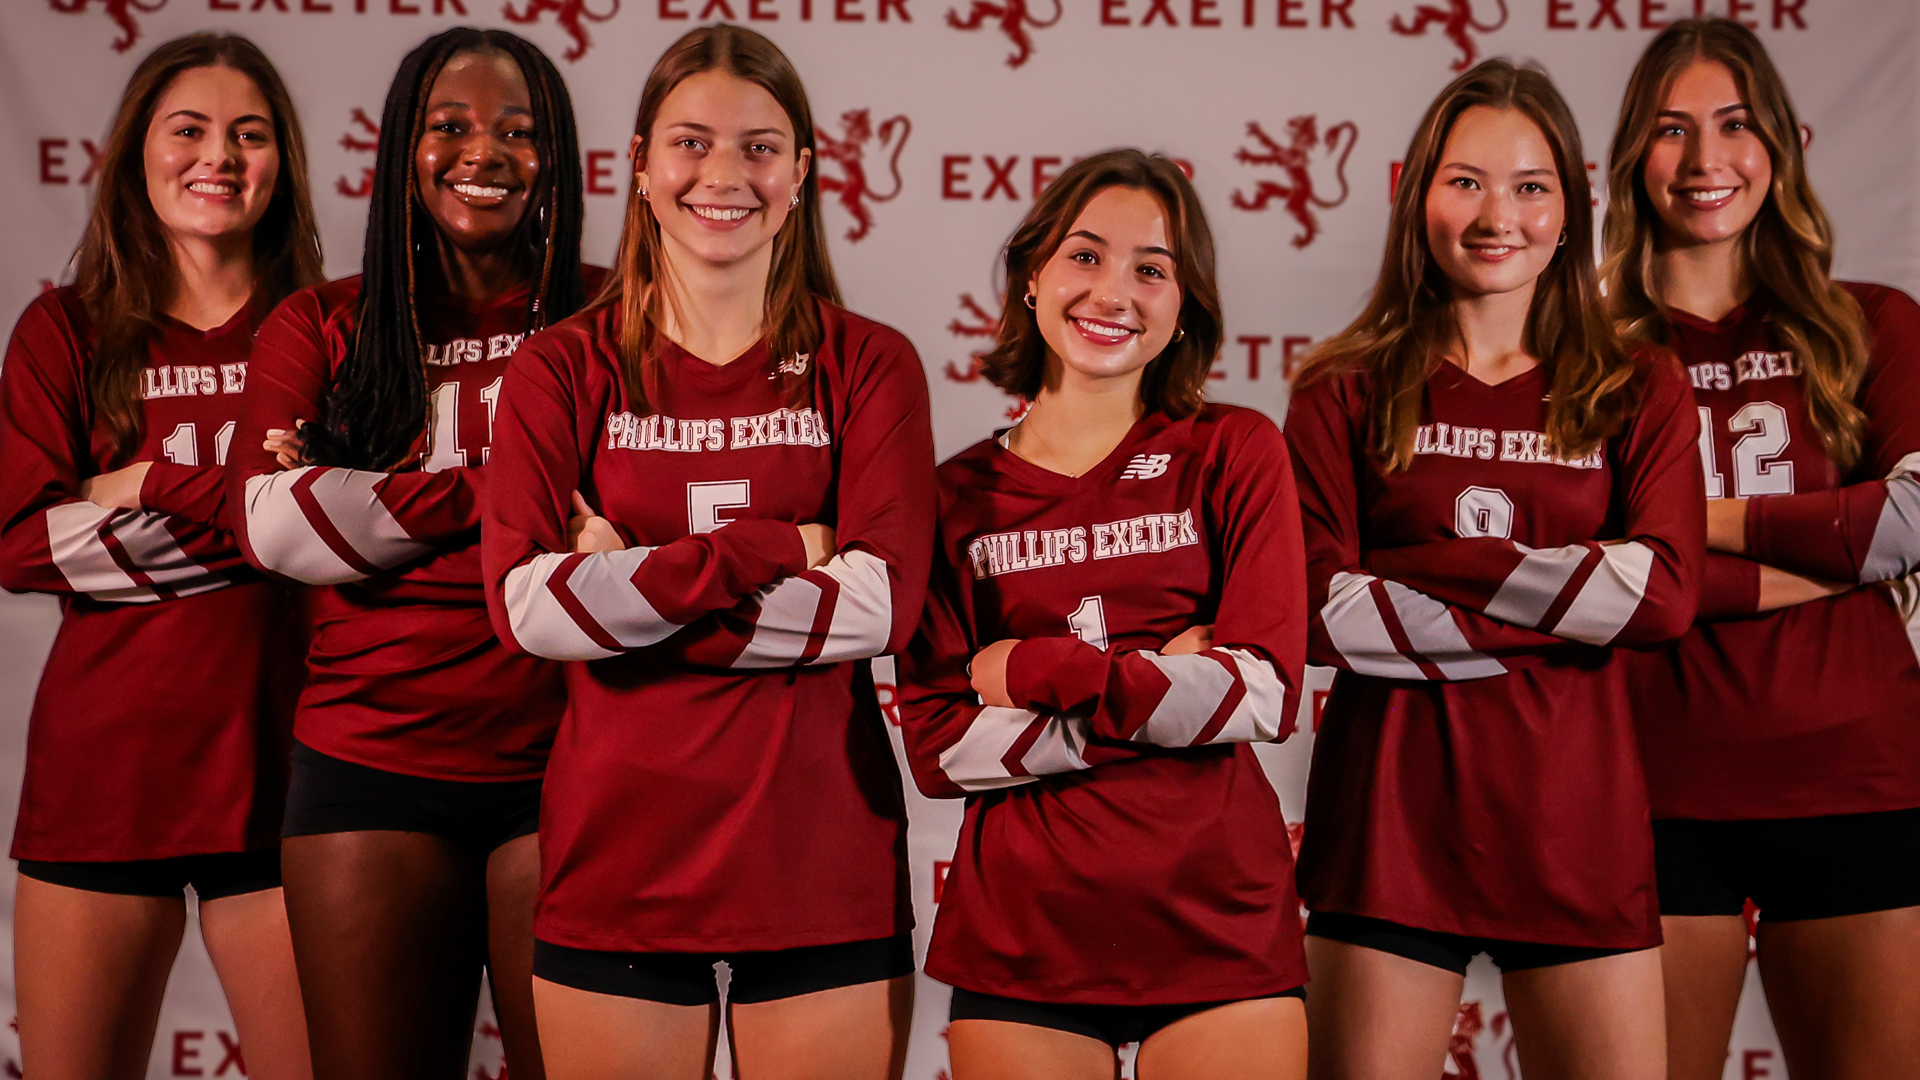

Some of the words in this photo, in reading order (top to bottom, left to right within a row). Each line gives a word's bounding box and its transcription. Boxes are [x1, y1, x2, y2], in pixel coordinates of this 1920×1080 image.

[425, 337, 482, 367] LIPS
[140, 365, 218, 400] LLIPS
[606, 411, 725, 452] PHILLIPS
[730, 407, 831, 447] EXETER
[1413, 422, 1497, 461] ILLIPS
[968, 526, 1088, 581] PHILLIPS
[1091, 508, 1199, 561] EXETER
